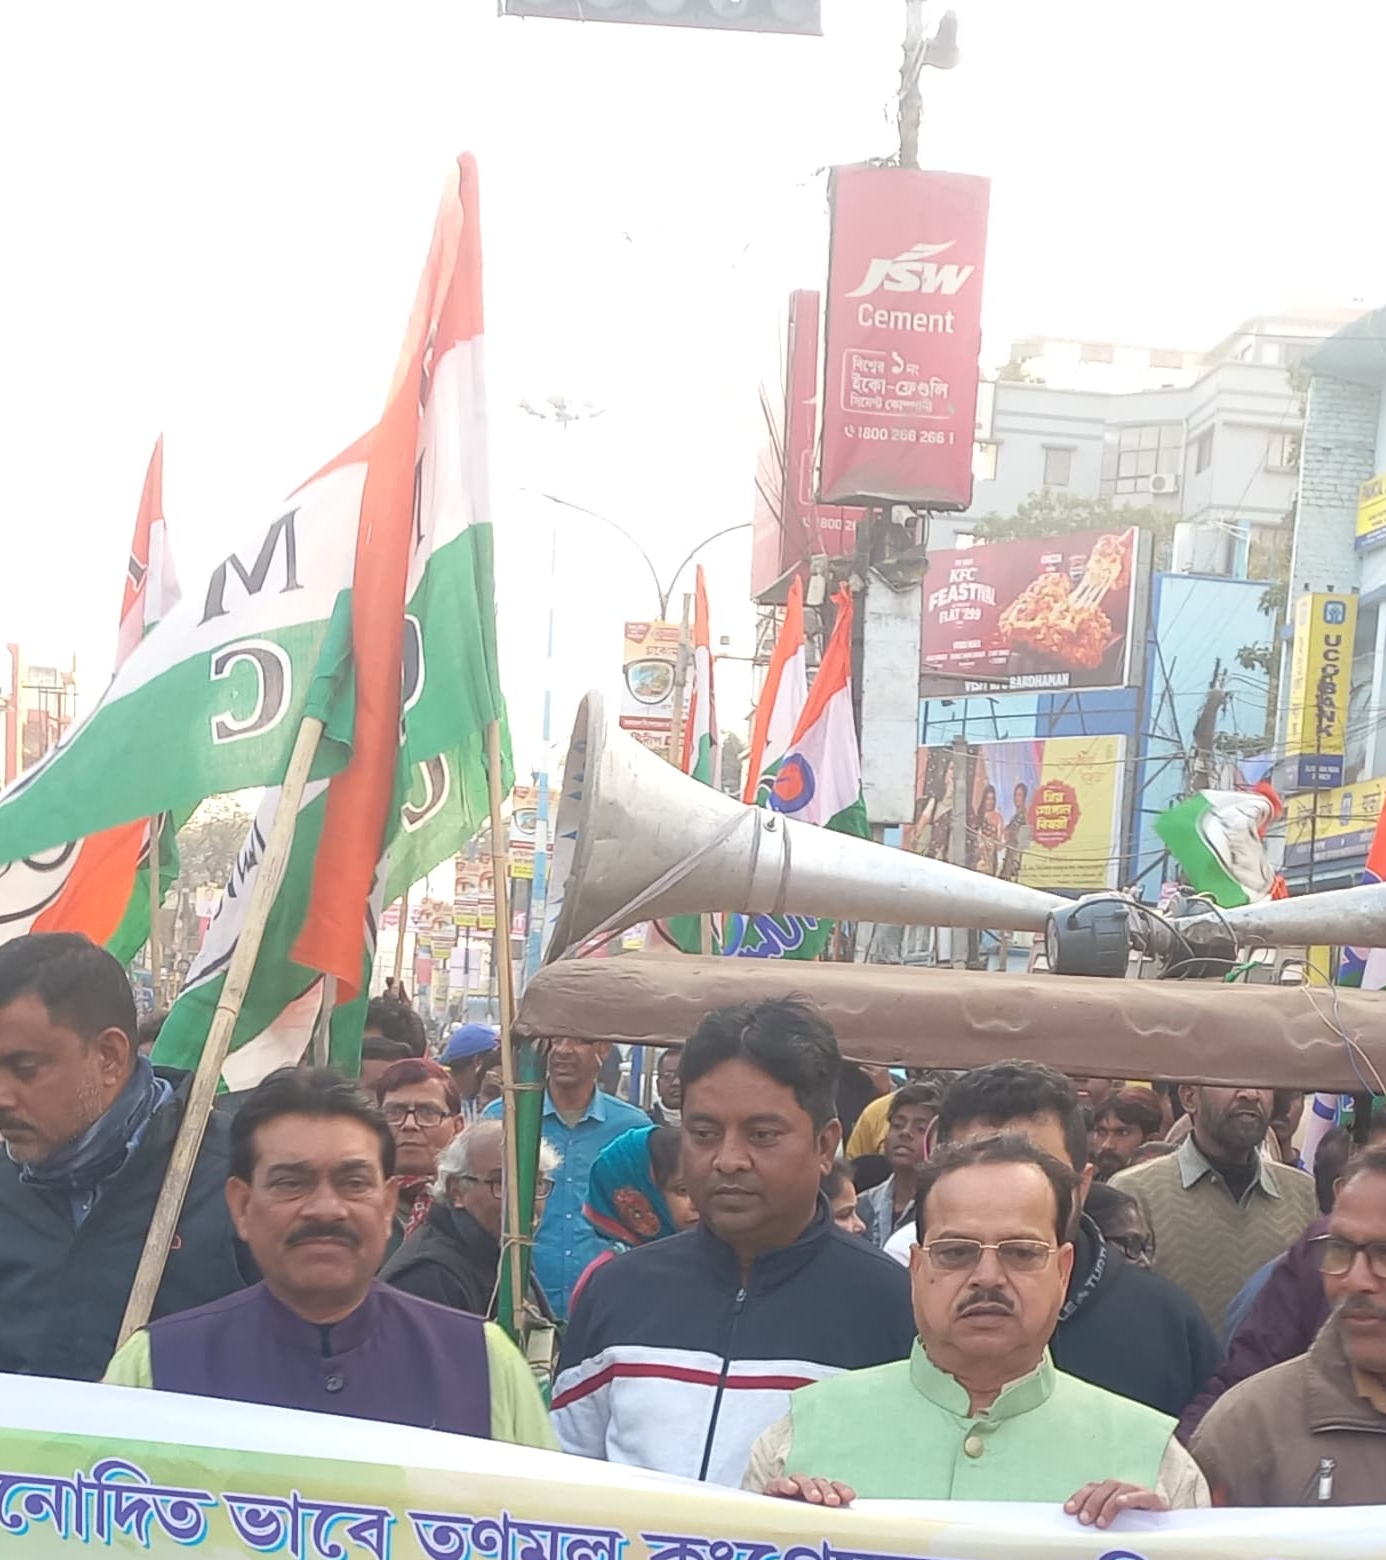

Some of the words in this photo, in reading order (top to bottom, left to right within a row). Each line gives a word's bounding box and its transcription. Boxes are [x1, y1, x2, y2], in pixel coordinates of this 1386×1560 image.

[845, 258, 975, 298] JSW
[858, 303, 955, 334] Cement
[858, 427, 888, 440] 1800
[949, 568, 978, 582] KFC
